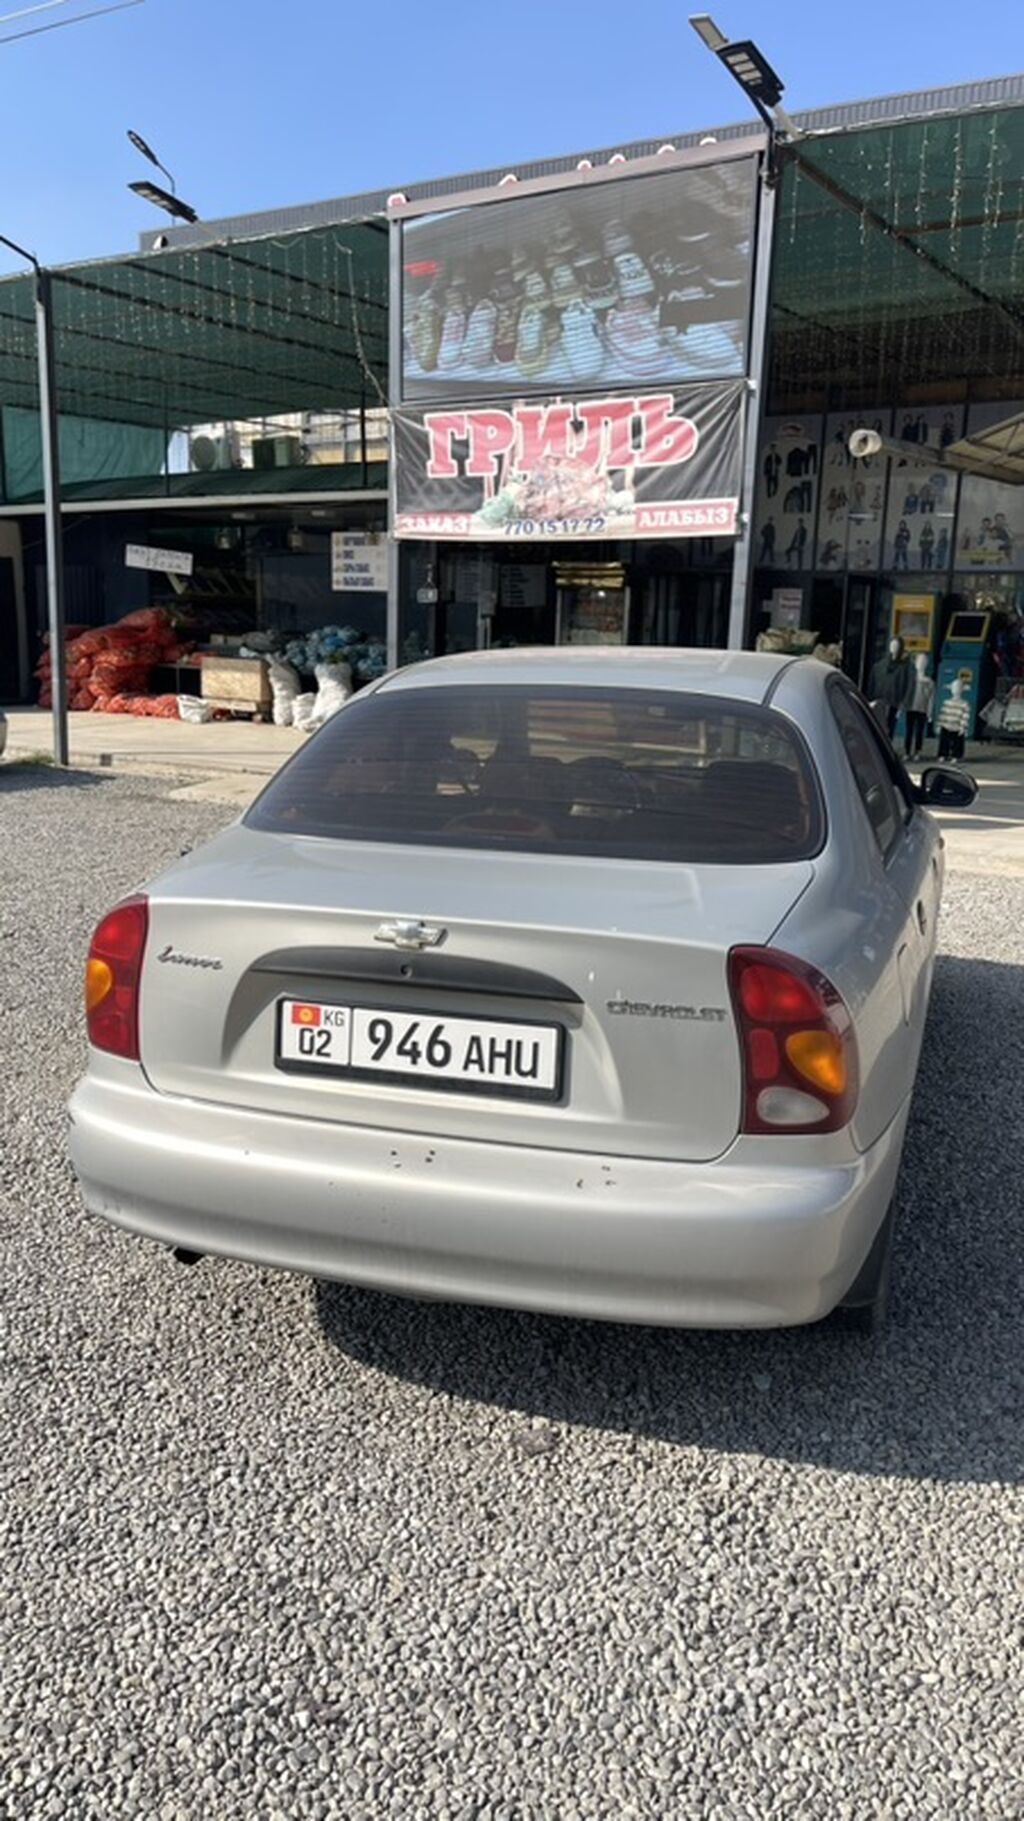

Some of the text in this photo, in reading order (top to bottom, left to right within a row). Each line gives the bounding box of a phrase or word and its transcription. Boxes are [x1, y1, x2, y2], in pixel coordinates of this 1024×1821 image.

[424, 394, 699, 478] ГРИЛЬ
[400, 515, 468, 533] ЗАКАЗ
[638, 507, 730, 529] АЛАБЫЗ
[323, 1009, 344, 1027] KG
[299, 1027, 332, 1058] 02
[367, 1018, 540, 1079] 946 AHU
